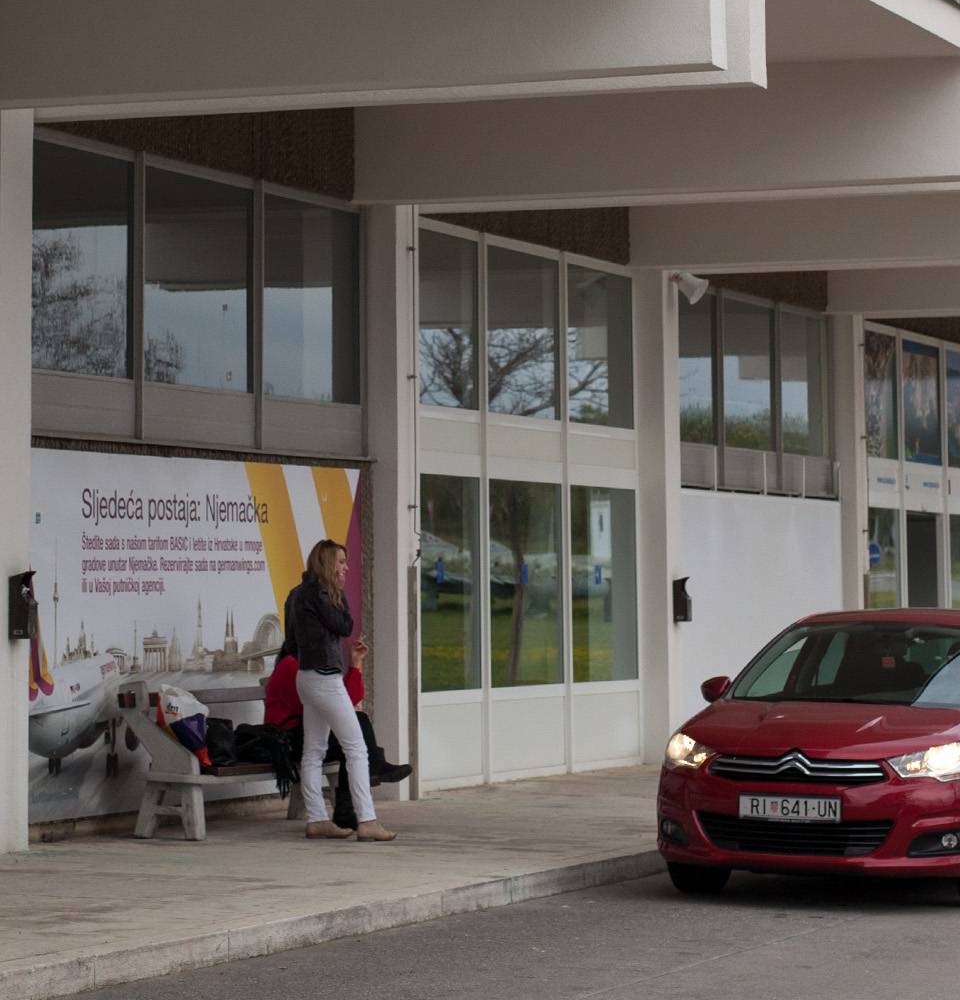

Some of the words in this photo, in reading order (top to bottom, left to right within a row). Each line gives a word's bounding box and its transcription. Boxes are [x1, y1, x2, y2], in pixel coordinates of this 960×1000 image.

[82, 488, 143, 526] Sljedeća
[148, 492, 201, 529] postaja:
[205, 494, 268, 529] Njemačka
[105, 536, 120, 551] sada
[170, 536, 188, 551] BASIC
[214, 537, 238, 551] Hrvatske
[82, 557, 106, 575] gradove
[108, 557, 127, 571] unutar
[195, 557, 208, 571] sada
[209, 560, 216, 571] na
[217, 557, 265, 574] germanwings.com
[95, 577, 111, 596] Vašoj
[750, 798, 766, 815] RI
[780, 799, 837, 818] 641-UN
